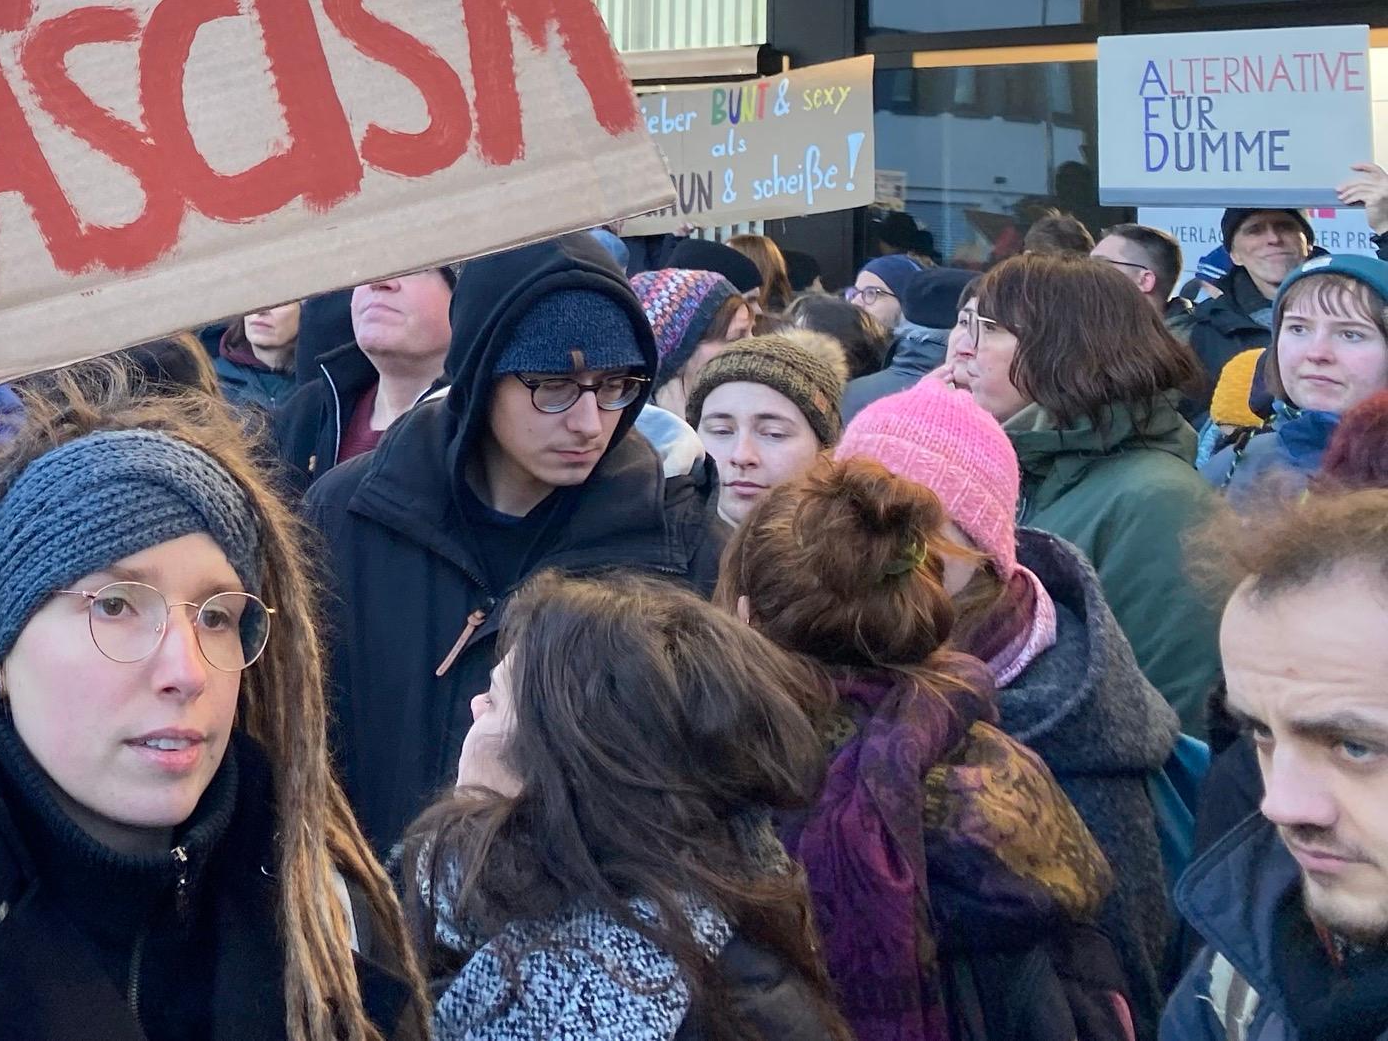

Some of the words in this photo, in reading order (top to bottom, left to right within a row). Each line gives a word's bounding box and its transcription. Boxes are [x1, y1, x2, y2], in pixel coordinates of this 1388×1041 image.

[1139, 52, 1365, 95] ALTERNATIVE
[641, 96, 697, 134] ieber
[711, 82, 771, 126] BUNT
[773, 78, 790, 116] &
[803, 86, 851, 114] sexy
[1143, 94, 1218, 131] FÜR
[711, 127, 748, 157] als
[1143, 129, 1290, 172] DUMME
[721, 168, 737, 204] &
